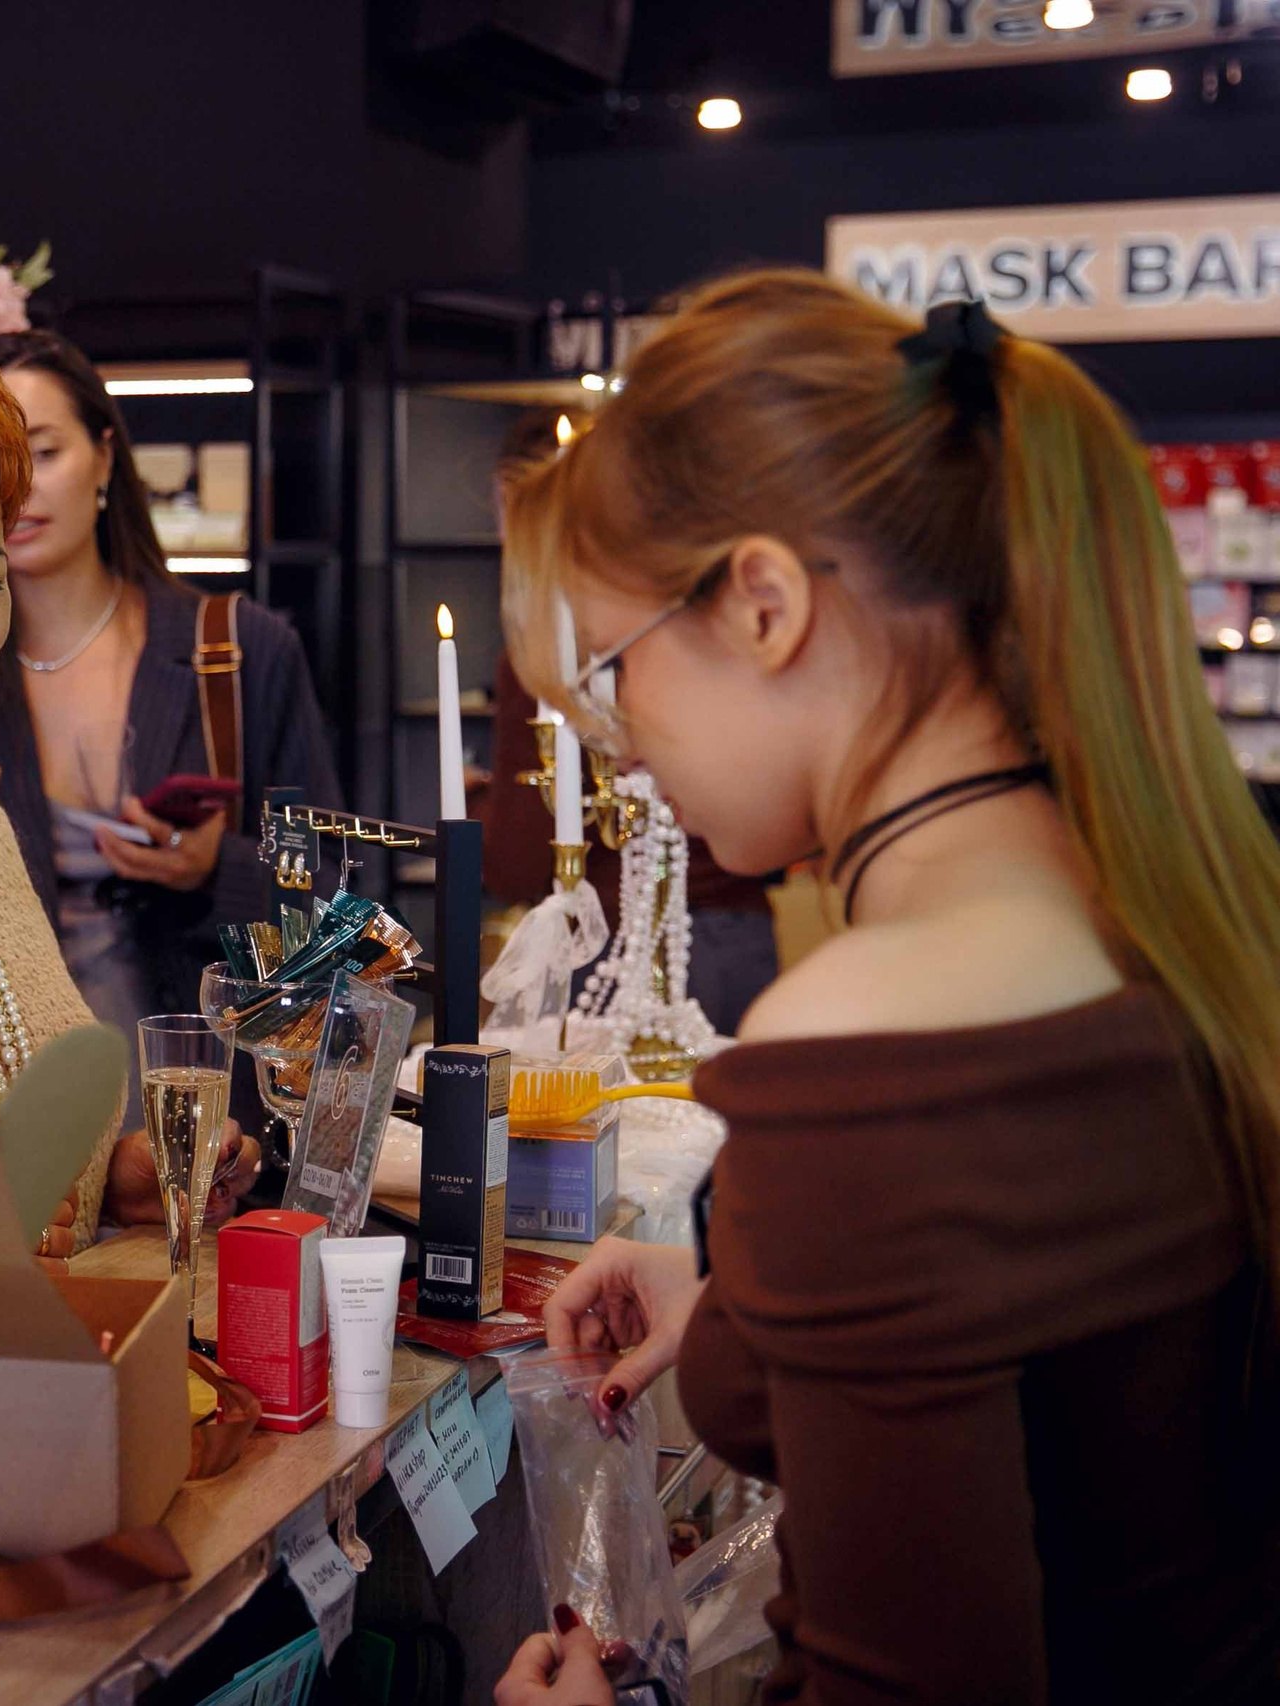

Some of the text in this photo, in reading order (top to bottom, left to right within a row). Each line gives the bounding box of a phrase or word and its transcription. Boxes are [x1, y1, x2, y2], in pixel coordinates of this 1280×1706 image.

[856, 245, 1096, 306] MASK
[342, 958, 364, 974] 100
[430, 1173, 473, 1184] TINCHEW
[362, 1369, 380, 1377] Ottie
